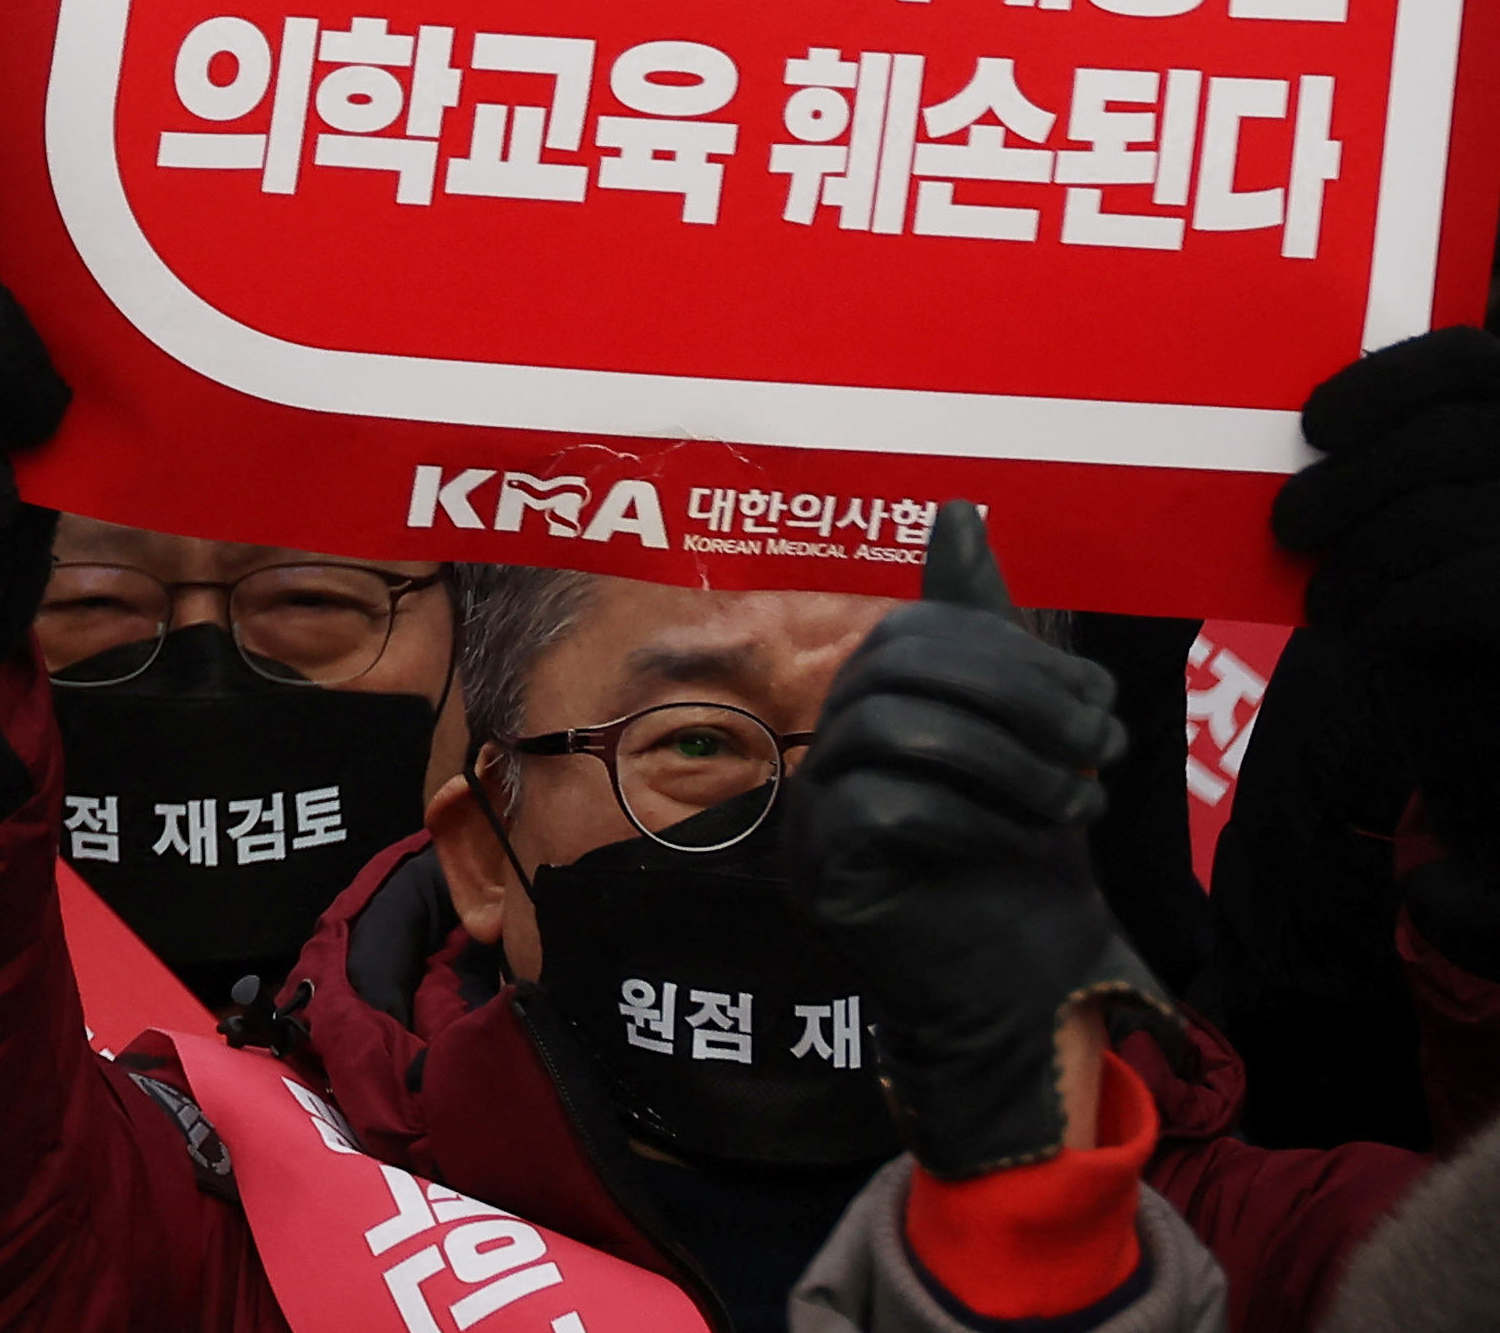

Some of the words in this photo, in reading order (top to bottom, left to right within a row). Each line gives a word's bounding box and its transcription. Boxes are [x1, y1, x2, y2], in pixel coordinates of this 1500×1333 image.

[156, 14, 742, 225] 의학교육
[770, 46, 1342, 260] 훼손된다
[407, 465, 670, 551] KMA
[686, 487, 989, 540] 대한의사협
[152, 785, 349, 871] 재검토
[618, 976, 756, 1066] 원점
[789, 996, 879, 1070] 재
